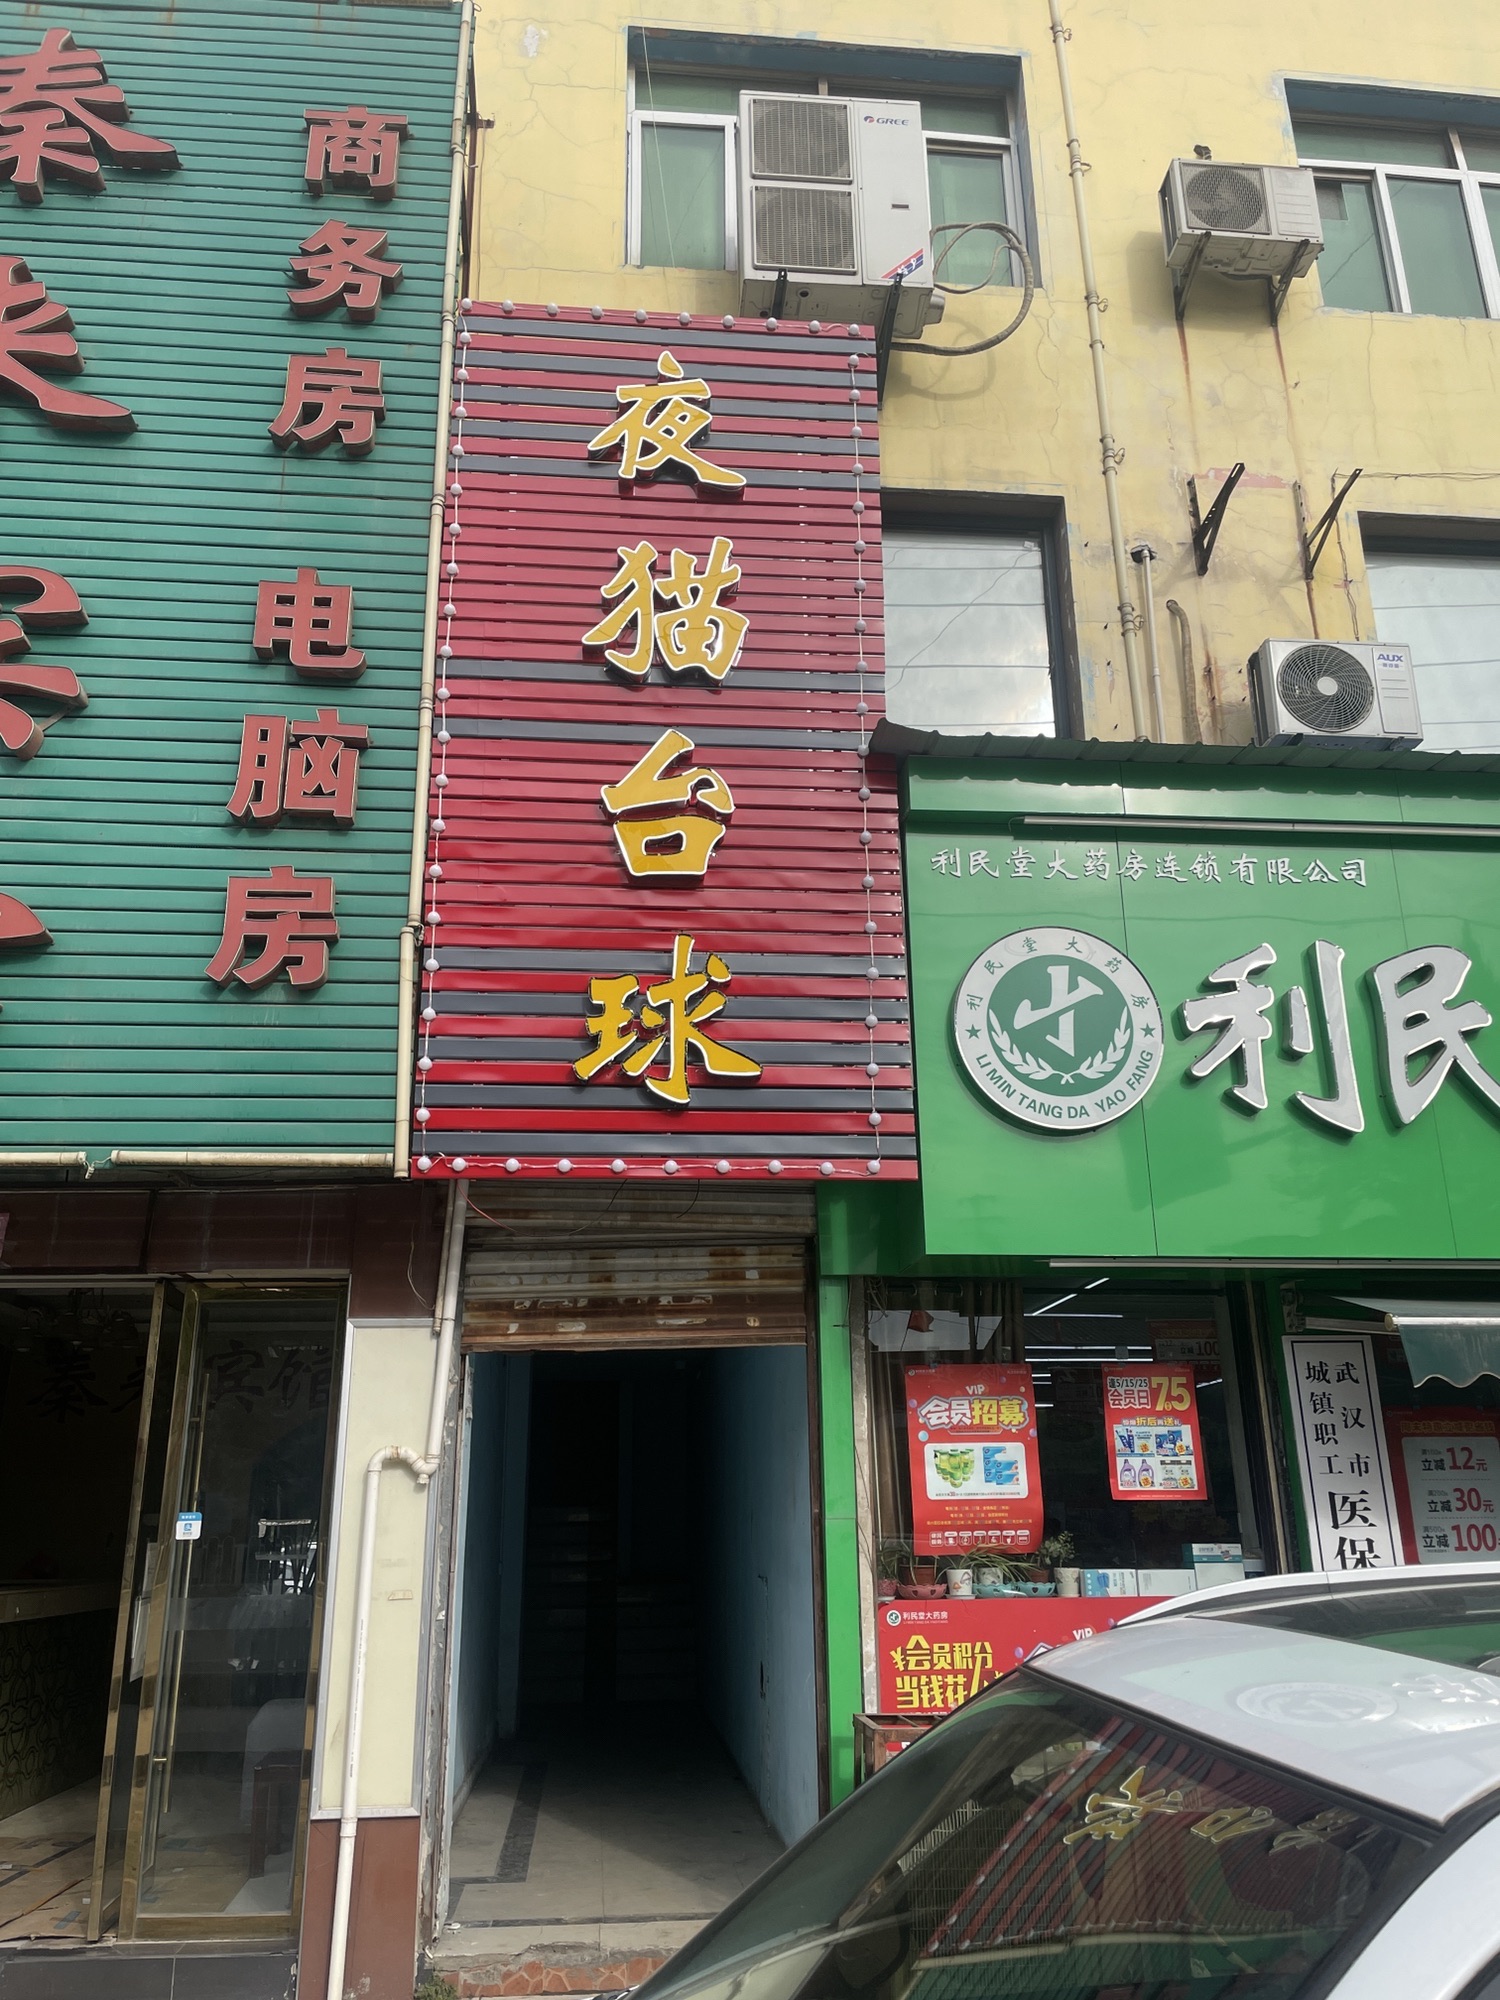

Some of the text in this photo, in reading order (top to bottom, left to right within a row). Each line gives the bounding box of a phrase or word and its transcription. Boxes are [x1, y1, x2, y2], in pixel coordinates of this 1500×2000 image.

[876, 117, 909, 126] GREE
[204, 105, 413, 990] 商务房 电脑房
[1377, 653, 1404, 662] AUX
[573, 349, 764, 1108] 夜猫台球
[930, 846, 1368, 888] 利民堂大药房连锁有限公司
[965, 935, 1151, 1012] 利民堂大药房
[1182, 938, 1500, 1133] 利民
[976, 1049, 1155, 1119] LI MIN TANG DA YAO FANG
[919, 1398, 1025, 1426] 会员招募
[966, 1384, 985, 1395] VIP
[1109, 1388, 1150, 1407] 会员日
[1305, 1360, 1344, 1475] 城镇职工
[1334, 1361, 1371, 1478] 武汉市
[1327, 1489, 1382, 1570] 医保
[1422, 1523, 1500, 1552] 立减100
[902, 1611, 949, 1620] 利民堂大药房
